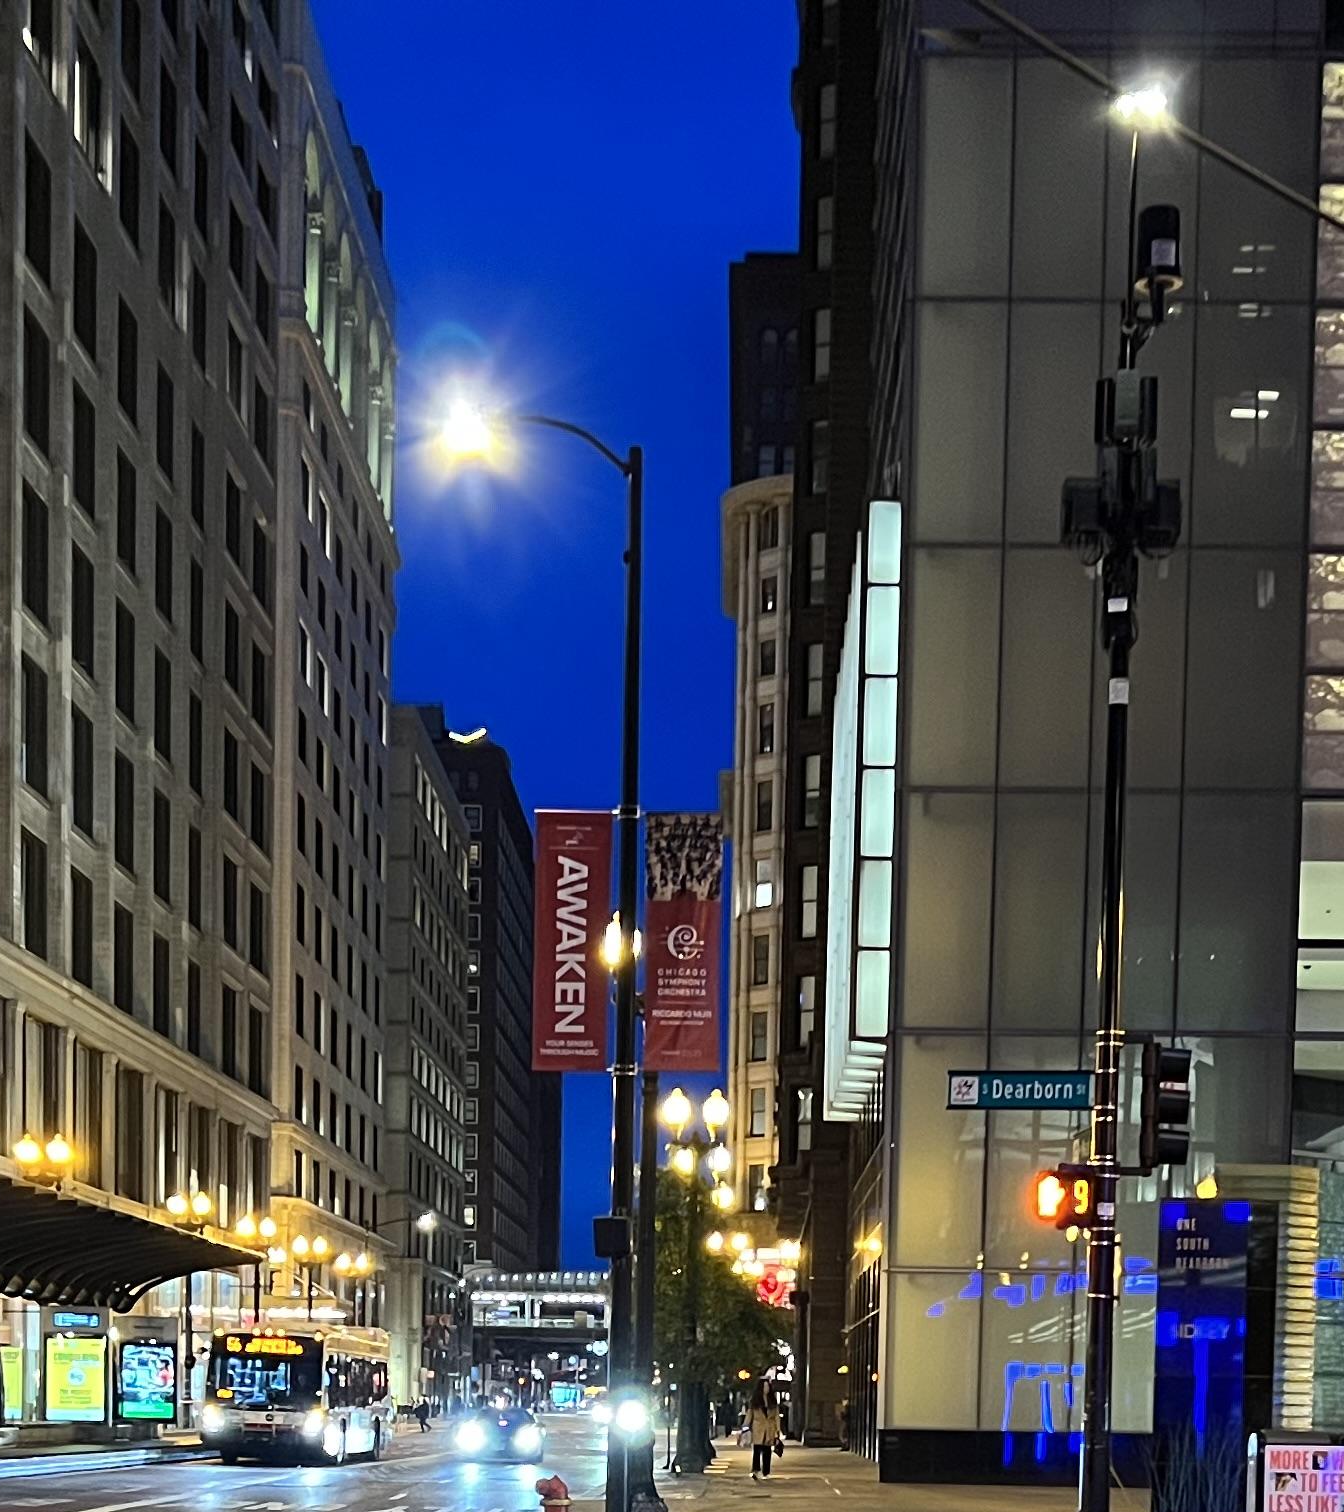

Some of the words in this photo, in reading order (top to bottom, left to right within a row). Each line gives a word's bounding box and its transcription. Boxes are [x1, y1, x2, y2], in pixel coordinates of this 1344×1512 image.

[555, 855, 589, 1033] AWAKEN
[657, 968, 707, 977] CHICAGO
[657, 978, 706, 986] SYMPHONY
[657, 987, 706, 997] ORCHESTRA
[992, 1079, 1073, 1099] Dearborn
[1073, 1179, 1089, 1214] 9
[1175, 1237, 1210, 1251] SOUTH
[1270, 1450, 1309, 1470] MORE
[1300, 1473, 1317, 1492] TO
